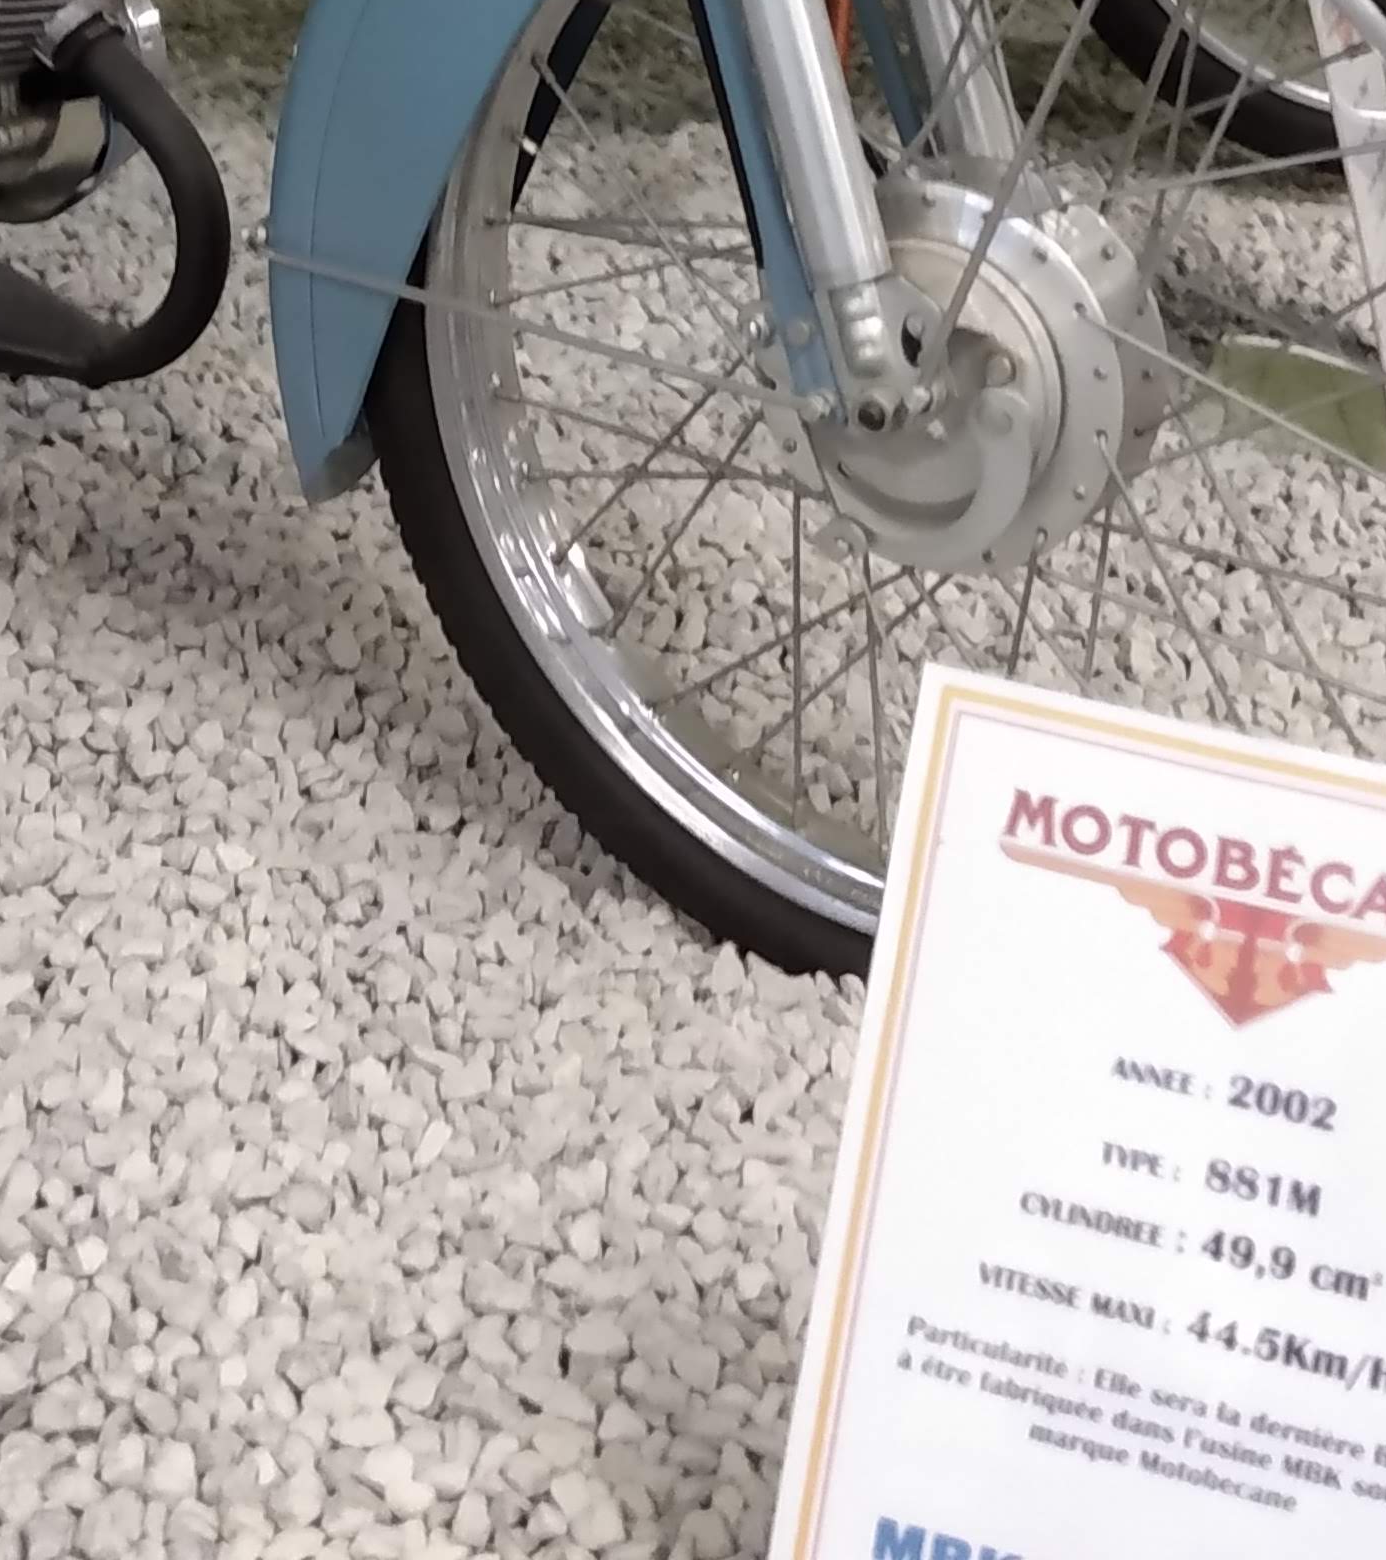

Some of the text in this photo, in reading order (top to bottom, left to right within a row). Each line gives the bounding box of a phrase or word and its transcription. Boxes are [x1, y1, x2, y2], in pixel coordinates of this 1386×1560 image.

[1228, 1075, 1338, 1132] 2002
[1102, 1140, 1165, 1179] TYPE
[1205, 1158, 1322, 1218] 881M
[1201, 1229, 1297, 1281] 49,9
[979, 1260, 1081, 1309] VITESSE
[1091, 1292, 1156, 1330] MAXI
[1093, 1367, 1142, 1399] Elle
[1150, 1388, 1209, 1419] sera
[1216, 1400, 1242, 1428] la
[1029, 1423, 1130, 1464] marque
[1112, 1410, 1175, 1445] dans
[1183, 1426, 1274, 1470] l'usine
[1282, 1454, 1343, 1491] MBK
